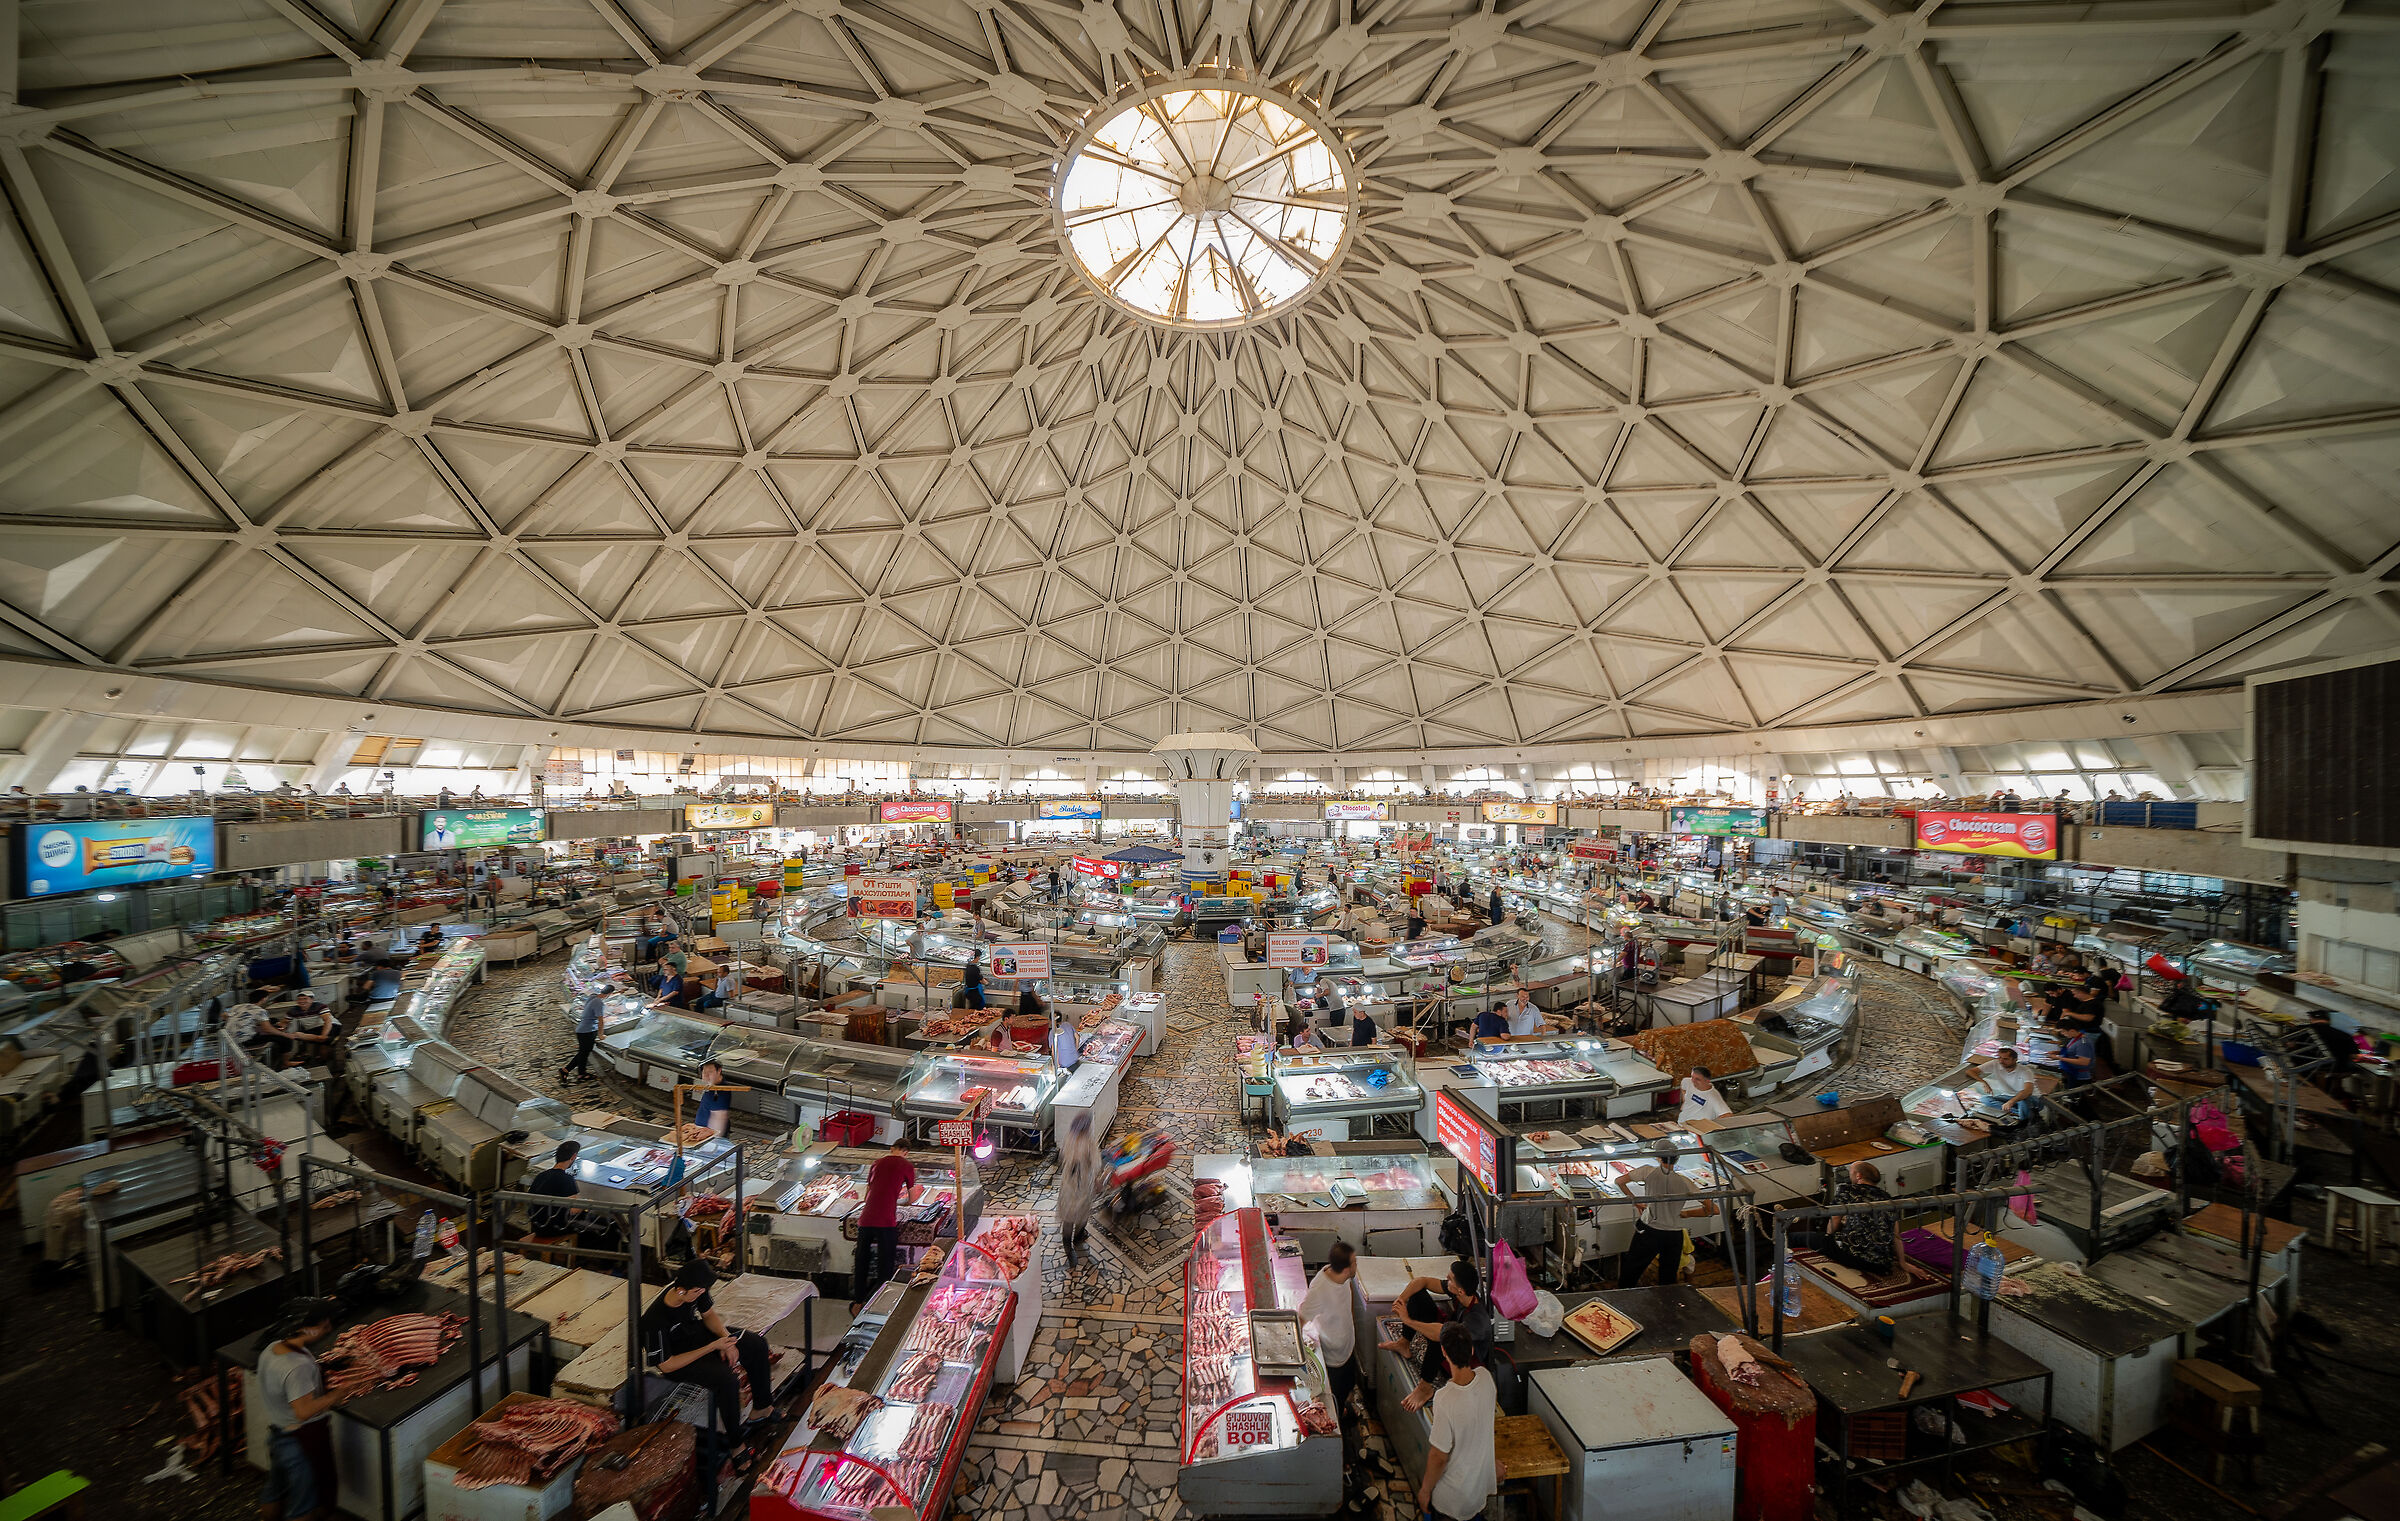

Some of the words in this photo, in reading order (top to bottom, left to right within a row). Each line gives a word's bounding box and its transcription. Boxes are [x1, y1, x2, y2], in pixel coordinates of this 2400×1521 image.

[1949, 818, 2017, 834] Chococream
[1226, 1421, 1271, 1431] SHASHLIK
[1227, 1431, 1270, 1445] BOR
